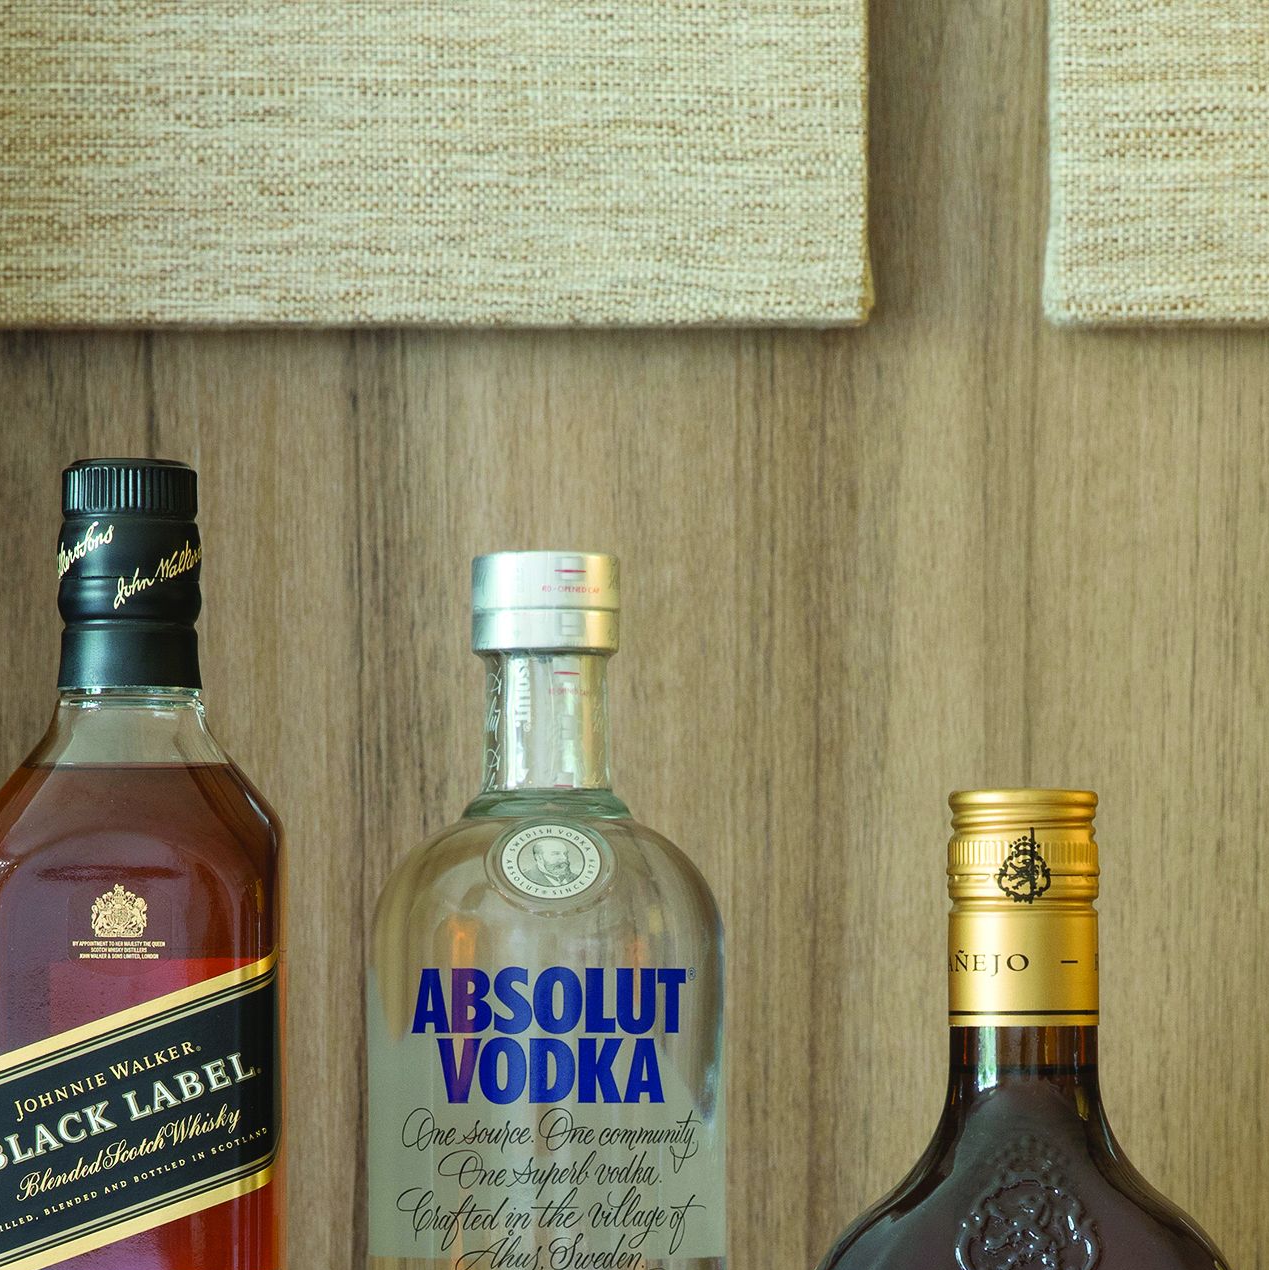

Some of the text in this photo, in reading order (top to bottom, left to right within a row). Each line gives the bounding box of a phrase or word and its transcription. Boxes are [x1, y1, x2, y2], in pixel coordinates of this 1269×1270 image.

[114, 568, 154, 609] John
[510, 829, 591, 852] SWEDISH VODKA
[507, 860, 539, 893] ABSOLUT
[552, 881, 585, 895] SINCE
[411, 965, 686, 1035] ABSOLUT
[14, 1040, 196, 1122] JOHNNIE WALKER
[122, 1052, 257, 1121] LABEL
[436, 1037, 665, 1105] VODKA
[16, 1103, 242, 1201] Blended Scotch Whisky
[402, 1107, 455, 1151] One
[539, 1107, 596, 1151] One
[43, 1191, 98, 1216] BLENDED
[104, 1180, 127, 1194] AND
[133, 1158, 186, 1183] BOTTLED
[191, 1151, 205, 1162] IN
[211, 1127, 268, 1155] SCOTLAND
[437, 1149, 662, 1198] One superb vodka.
[397, 1187, 508, 1251] Crafted
[505, 1204, 531, 1230] in
[530, 1187, 585, 1229] the
[669, 1194, 707, 1254] of
